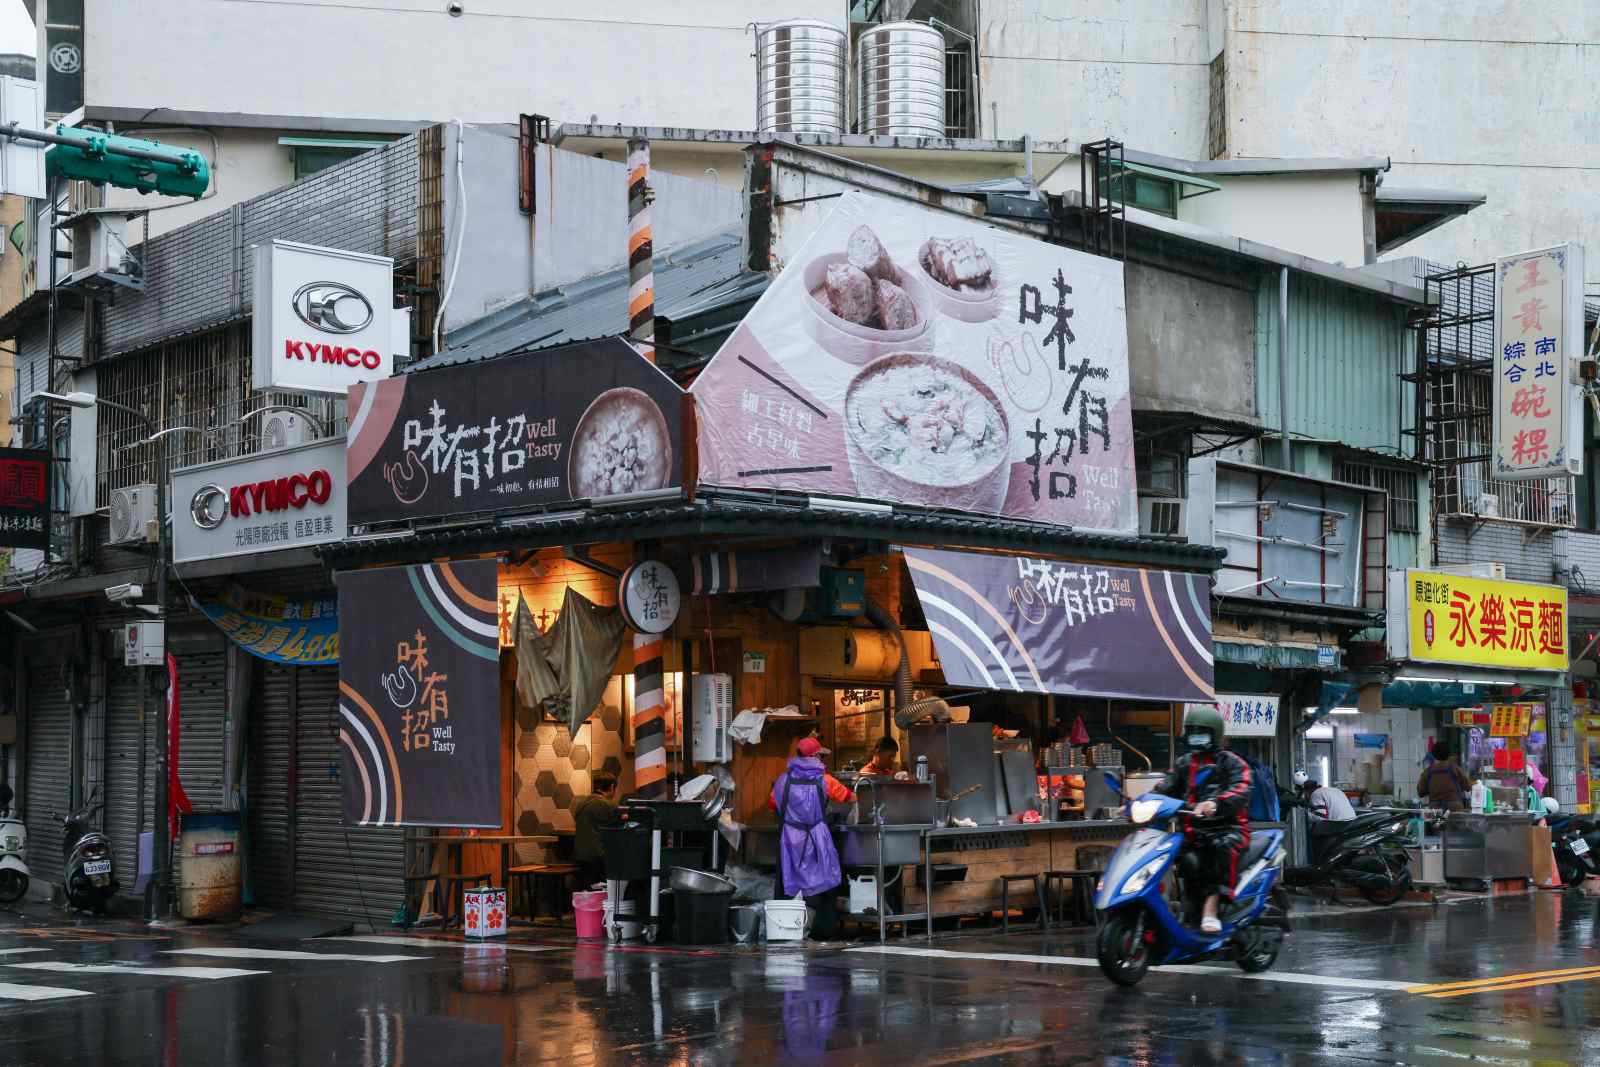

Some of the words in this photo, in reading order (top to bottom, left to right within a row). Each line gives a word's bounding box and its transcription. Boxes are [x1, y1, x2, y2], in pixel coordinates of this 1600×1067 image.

[285, 339, 381, 370] KYMCO
[1503, 341, 1527, 384] 綜合
[1534, 336, 1557, 379] 南北
[1019, 268, 1110, 501] 味有招
[526, 418, 556, 440] Well
[1510, 384, 1552, 465] 碗粿
[403, 399, 527, 498] 味有招
[526, 442, 562, 460] Tasty
[230, 470, 332, 518] KYMCO
[641, 565, 669, 621] 味有招
[1017, 557, 1114, 626] 味有招
[1111, 578, 1131, 593] Well
[1112, 593, 1136, 612] Tasty
[1449, 590, 1566, 655] 永樂涼麵
[397, 629, 448, 752] 味有招
[432, 726, 453, 739] Well
[432, 740, 456, 755] Tasty
